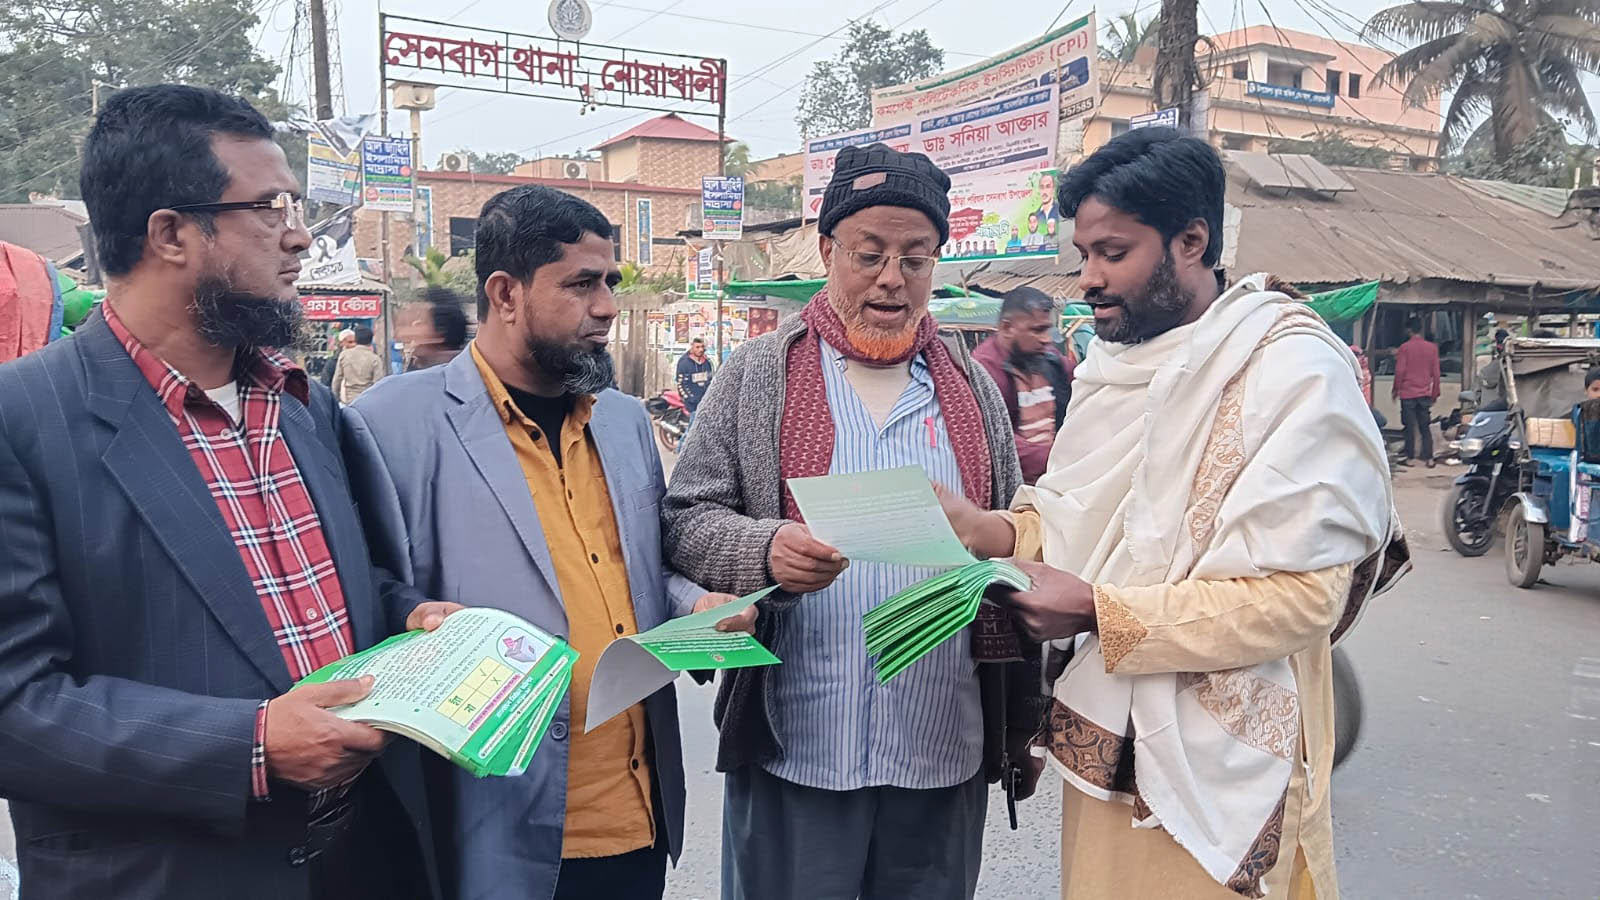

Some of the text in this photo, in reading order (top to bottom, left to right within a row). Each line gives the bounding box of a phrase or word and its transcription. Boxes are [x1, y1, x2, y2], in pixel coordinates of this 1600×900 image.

[1050, 31, 1089, 61] (CPI)
[384, 32, 504, 80] সেনবাগ
[602, 58, 724, 105] নোয়াখালী
[923, 136, 945, 152] ডাঃ
[949, 125, 992, 147] সনিয়া
[995, 111, 1050, 136] আক্তার
[464, 703, 477, 714] না
